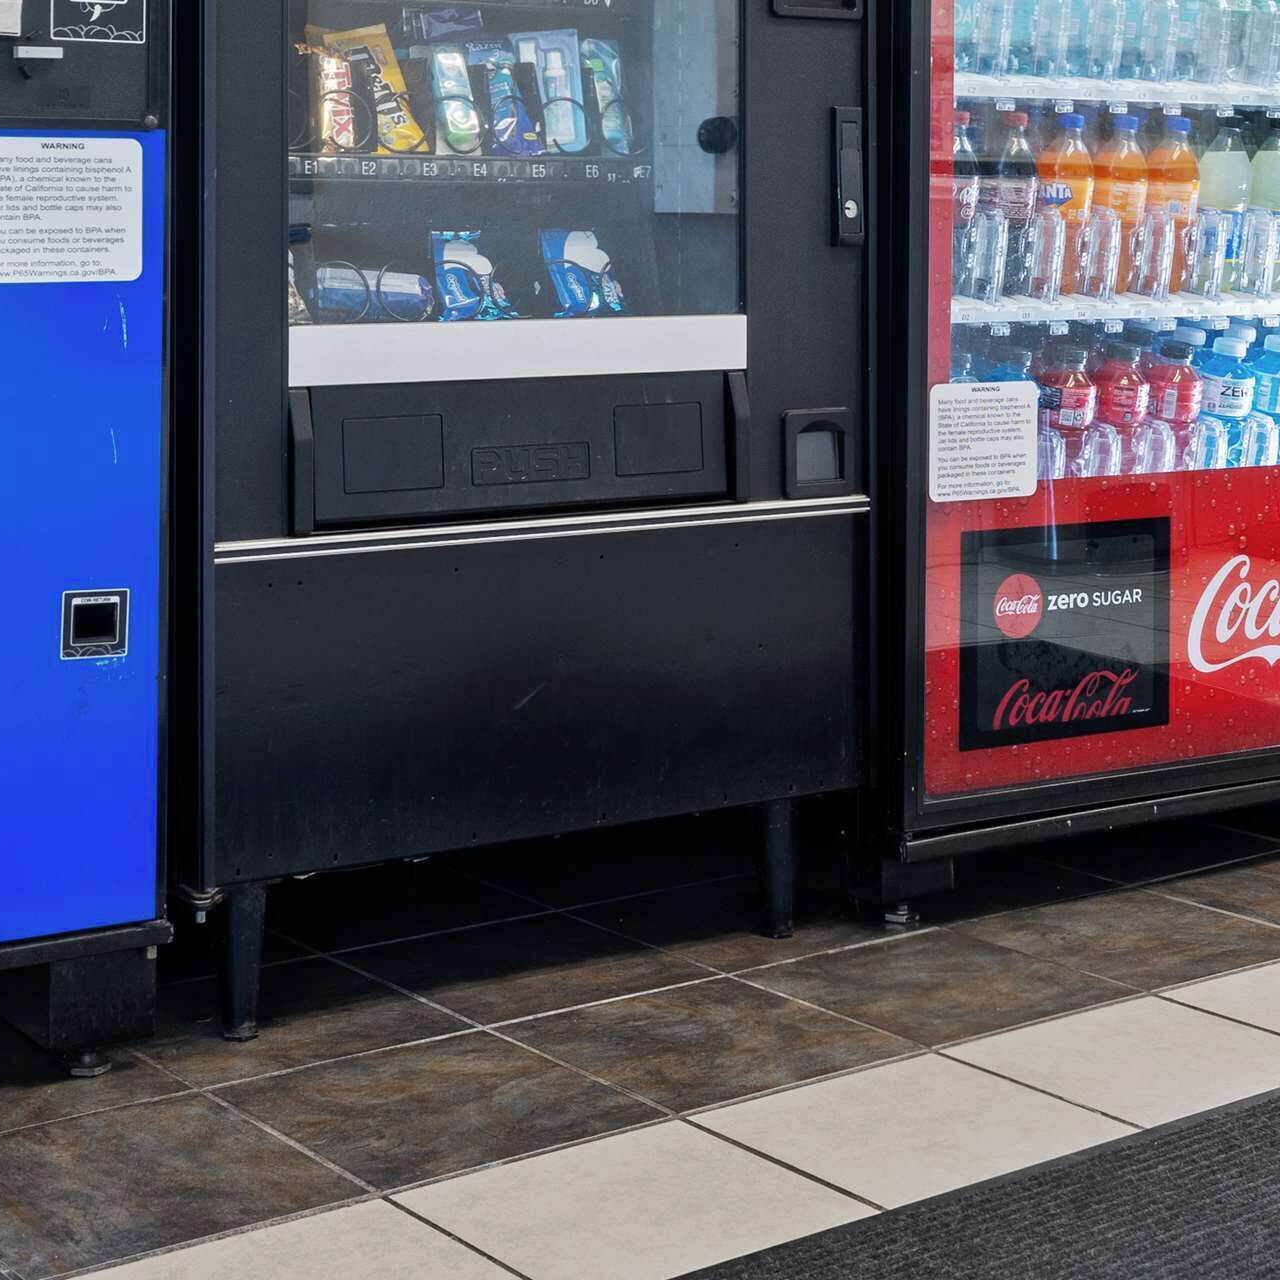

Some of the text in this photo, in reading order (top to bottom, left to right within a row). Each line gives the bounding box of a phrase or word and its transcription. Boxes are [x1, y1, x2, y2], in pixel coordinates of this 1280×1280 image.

[41, 142, 85, 150] WARNING
[53, 156, 91, 165] beverage
[13, 166, 39, 174] linings
[42, 166, 83, 174] containing
[85, 166, 124, 174] bisphenol
[305, 161, 652, 179] E1 E2 E3 E4 E5 E6 E7
[475, 442, 588, 483] PUSH
[995, 586, 1143, 618] Coca-Cola zero SUGAR
